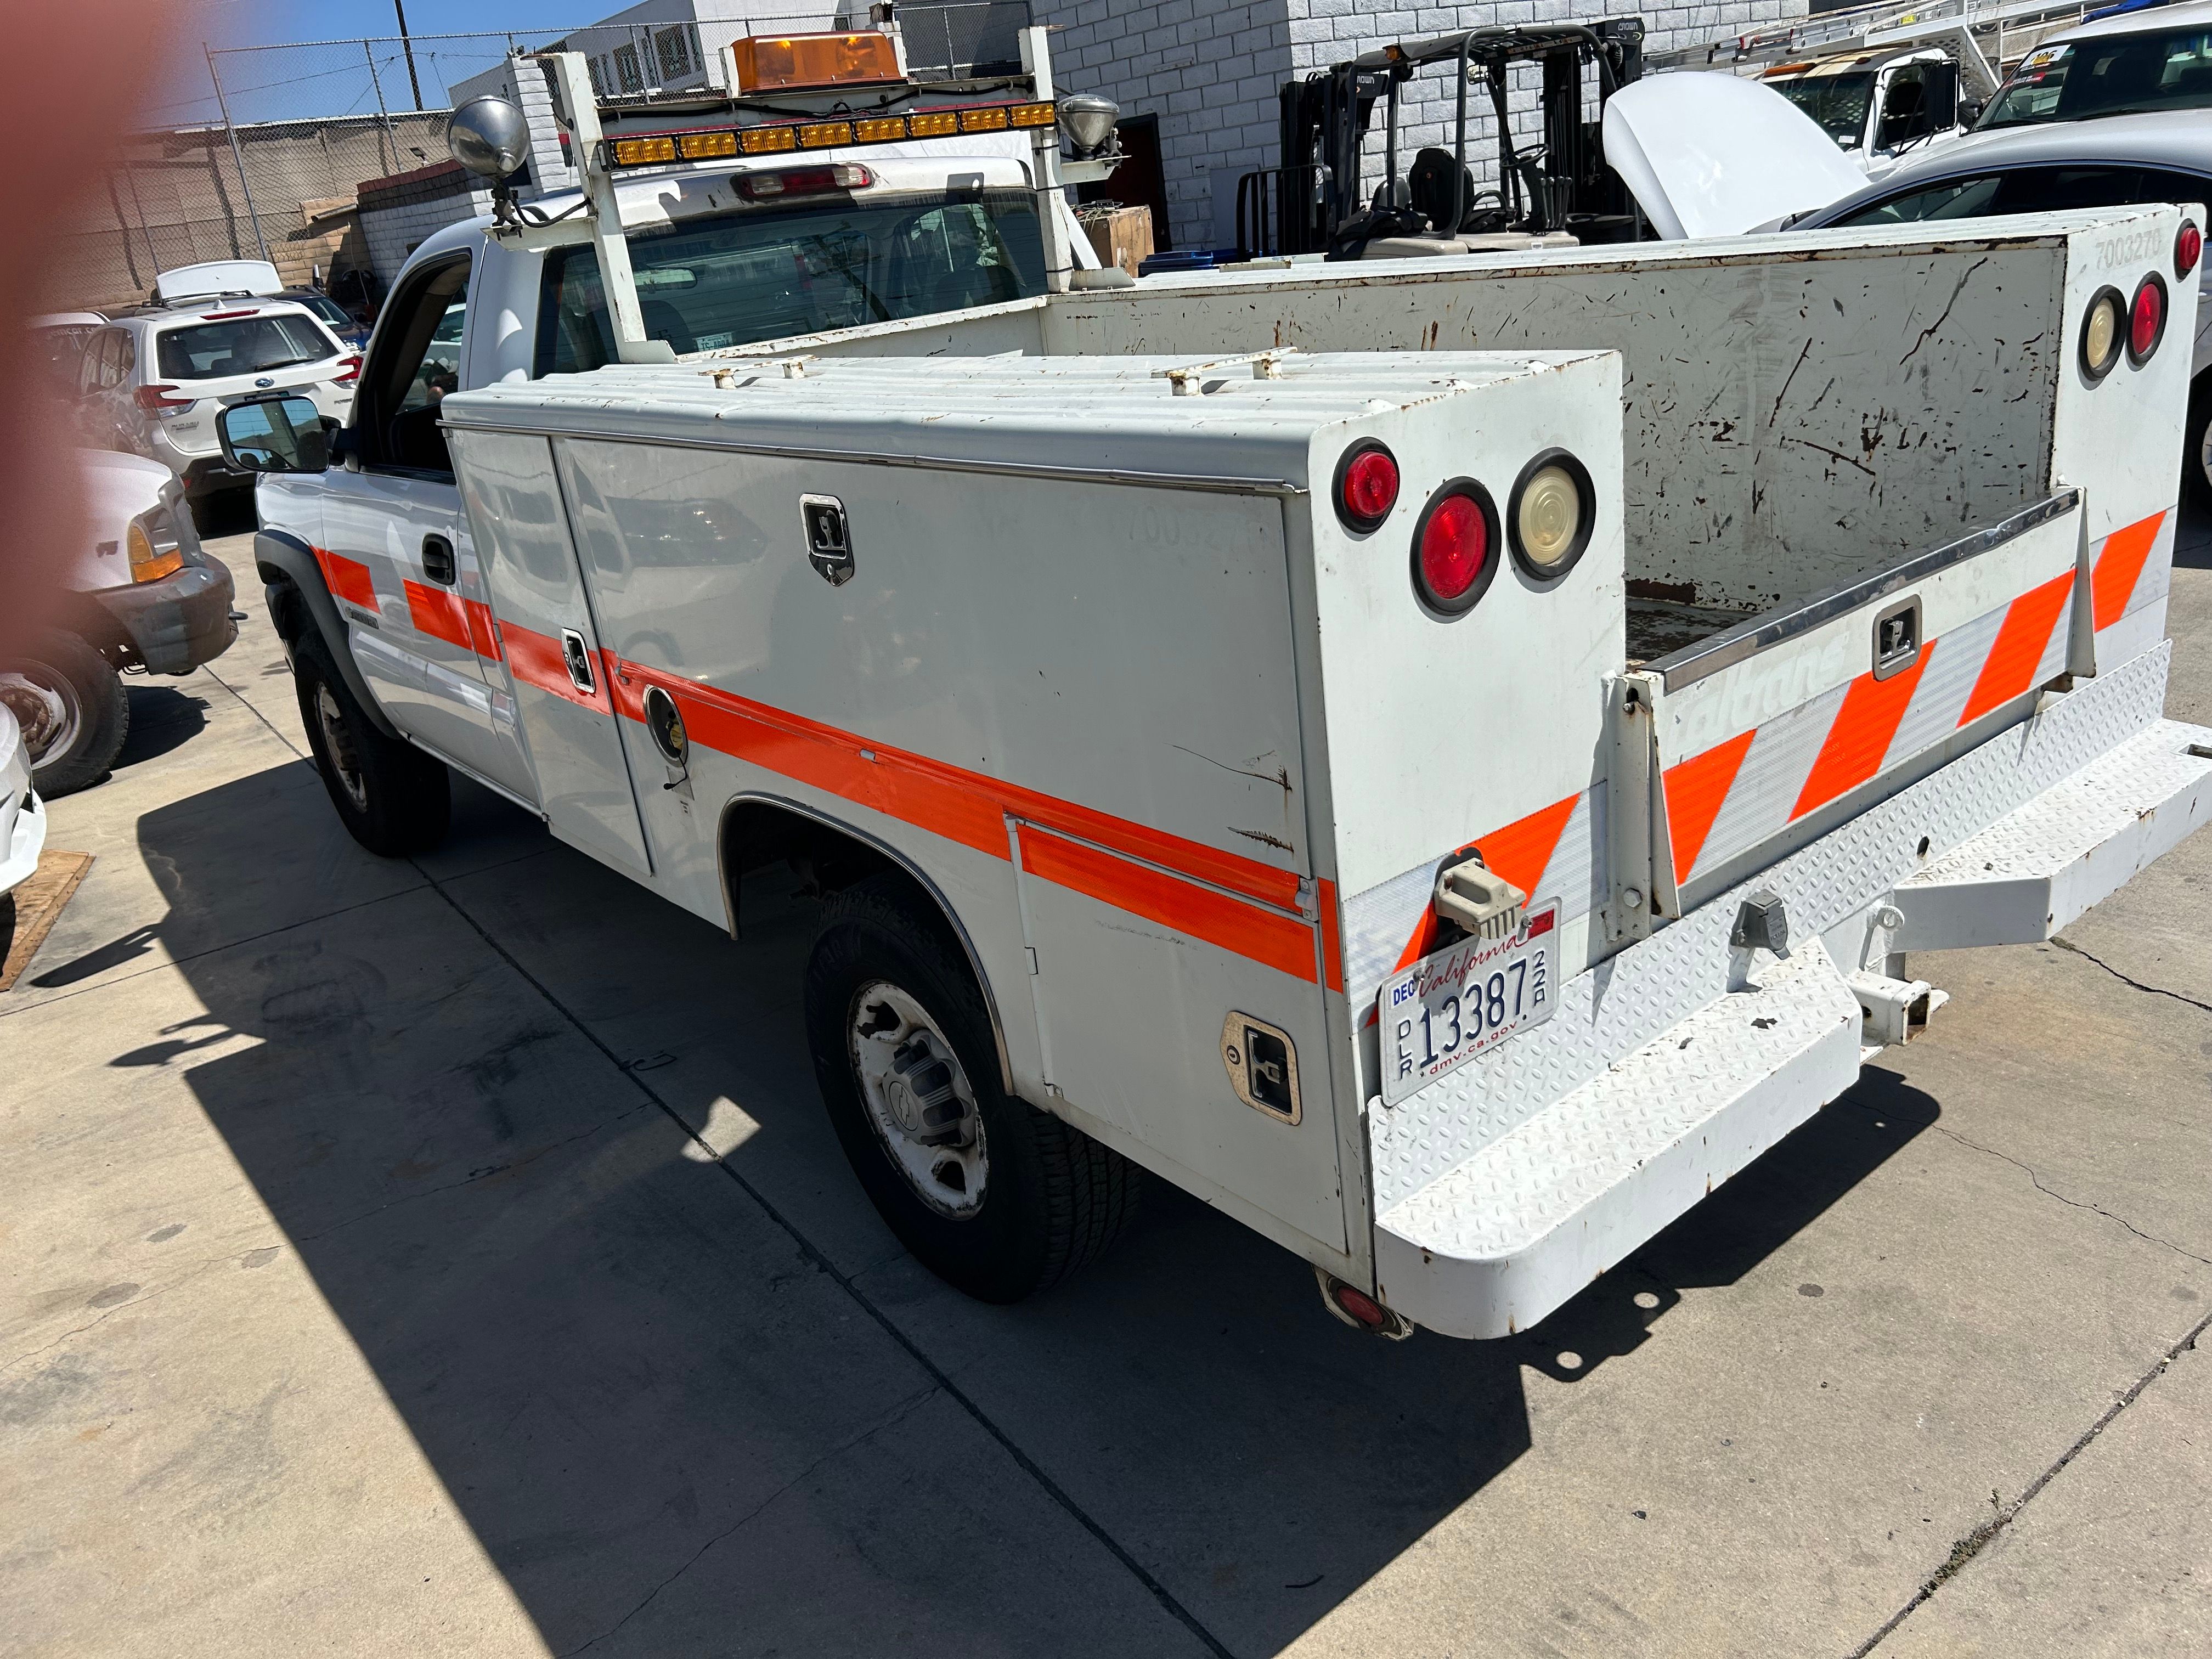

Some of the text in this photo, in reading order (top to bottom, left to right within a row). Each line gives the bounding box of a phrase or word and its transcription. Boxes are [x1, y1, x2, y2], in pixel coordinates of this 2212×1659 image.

[1393, 980, 1415, 1006] DEC
[1419, 931, 1528, 998] California
[1420, 958, 1527, 1068] 13387
[1430, 1021, 1517, 1075] dmv.ca.gov
